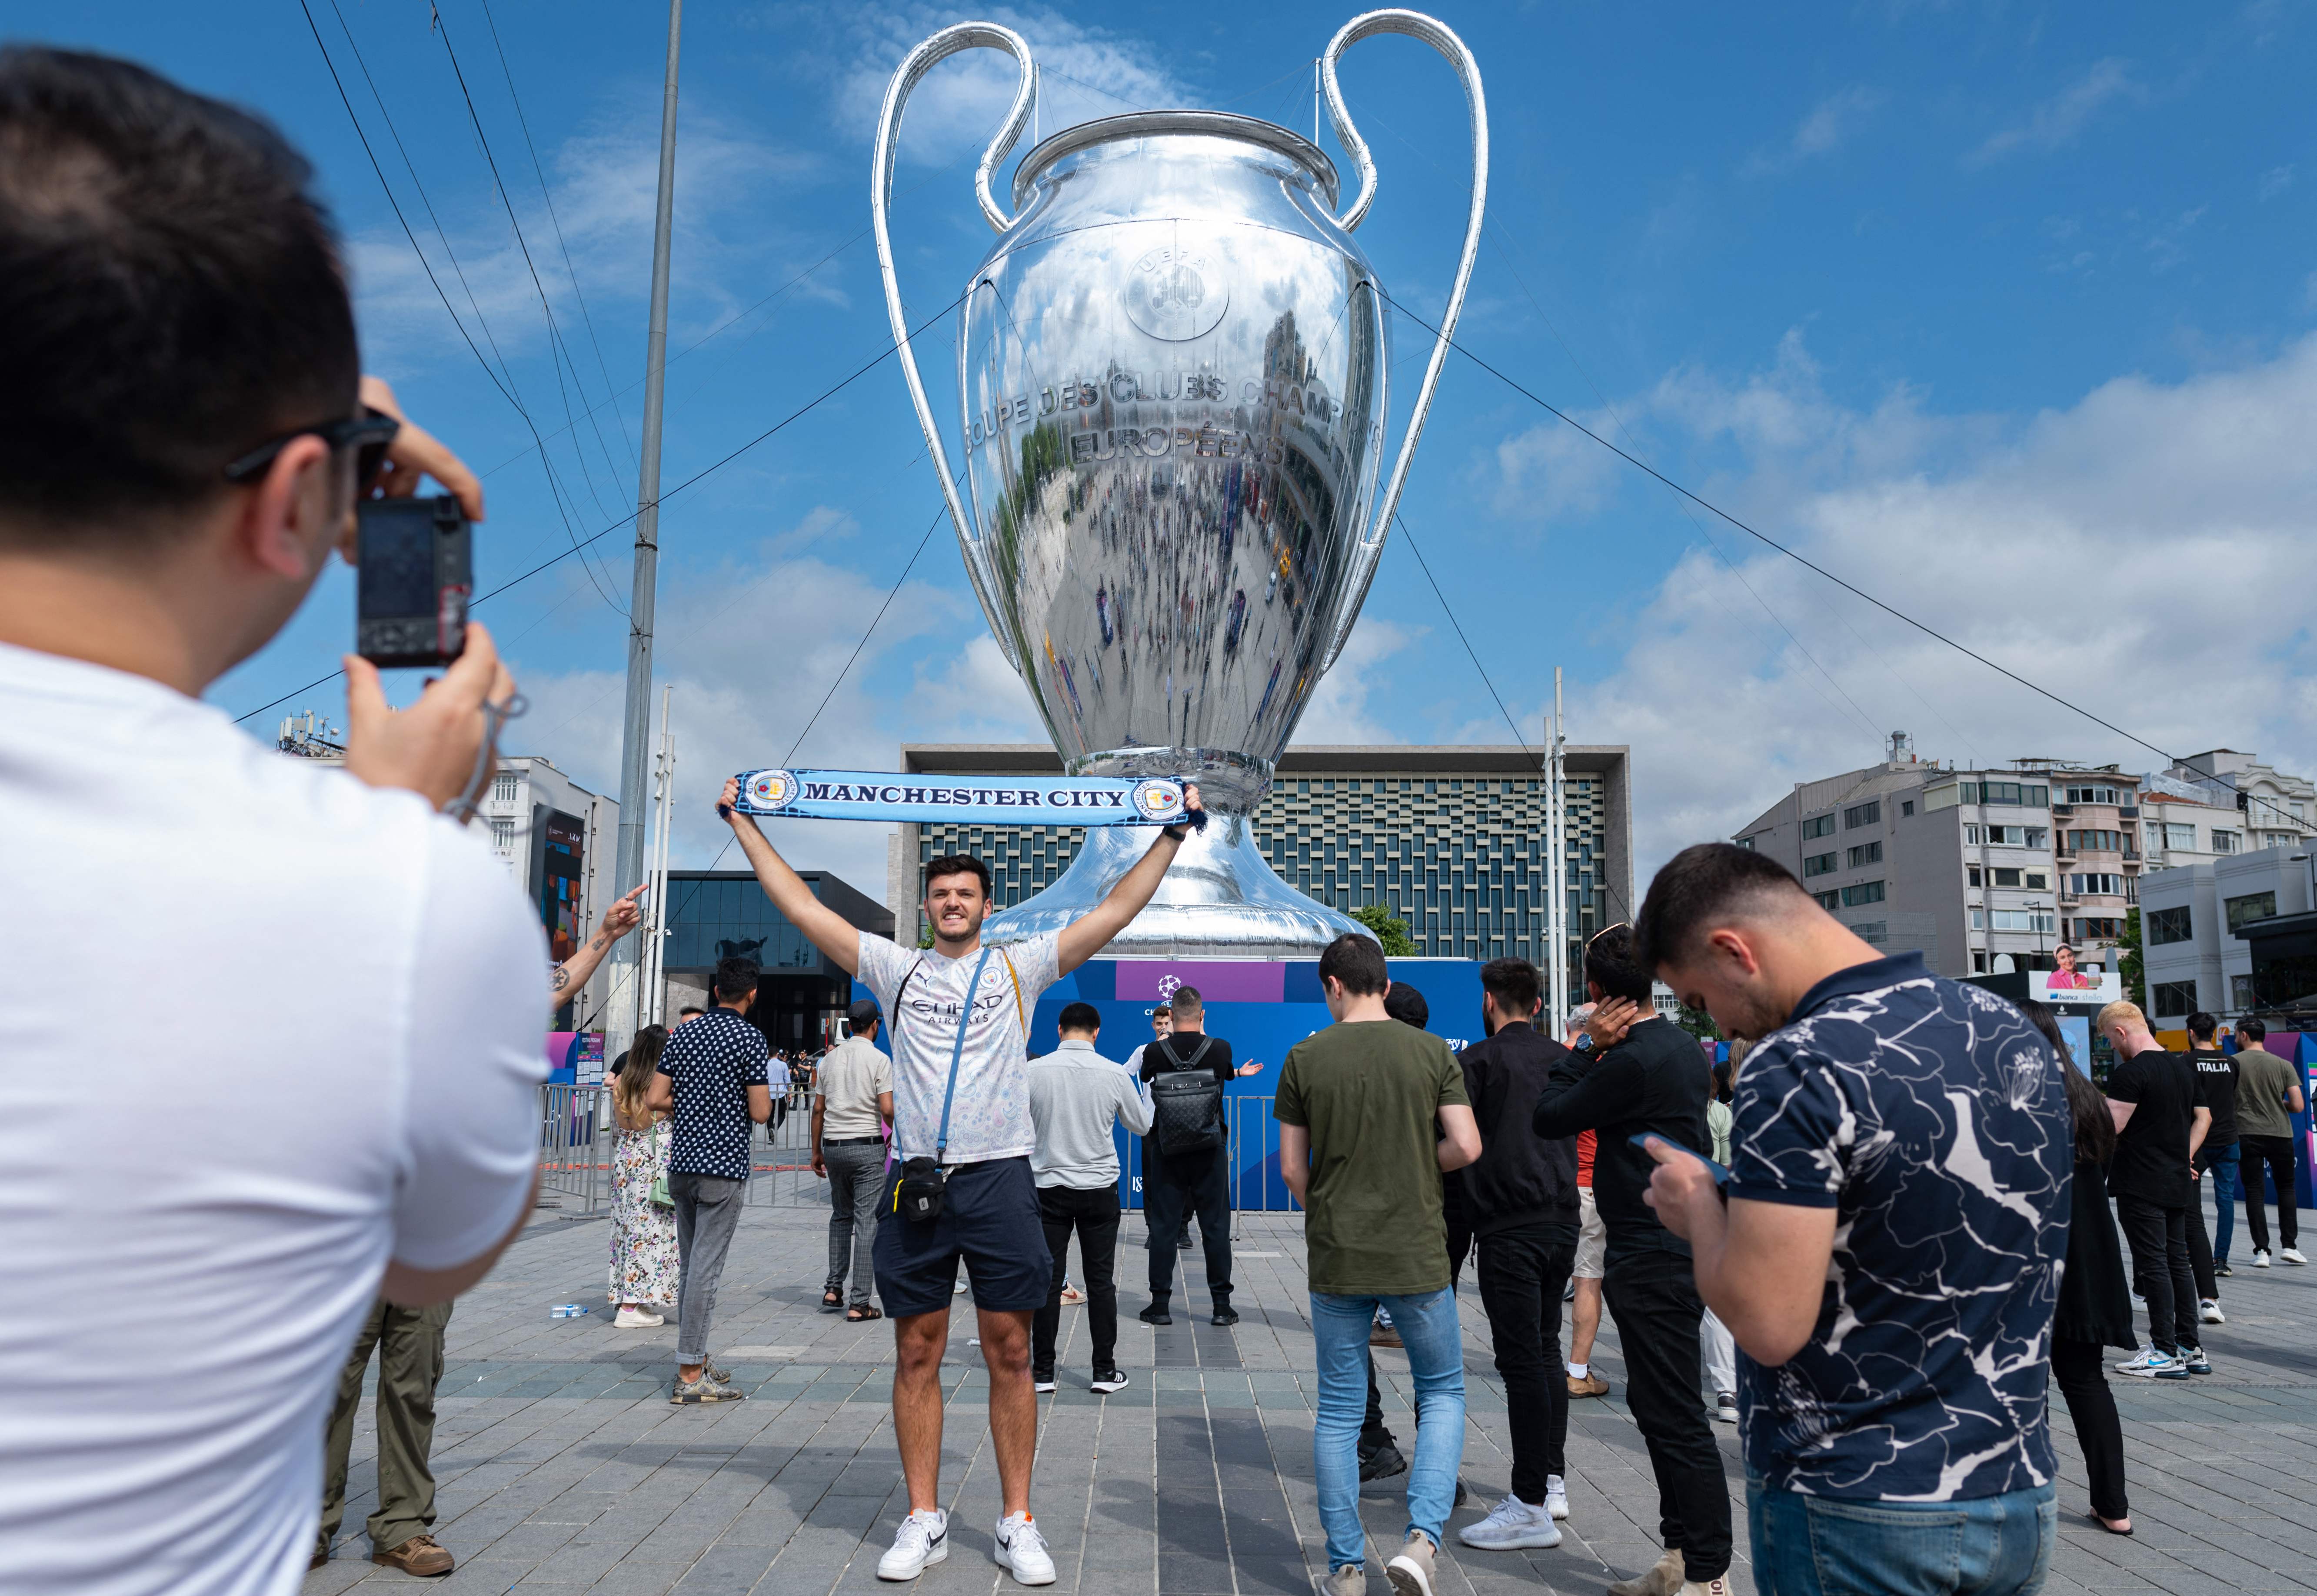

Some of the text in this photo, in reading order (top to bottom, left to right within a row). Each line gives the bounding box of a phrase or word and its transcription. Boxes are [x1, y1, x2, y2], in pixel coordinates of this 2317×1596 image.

[1139, 250, 1206, 273] UEFA
[966, 392, 1032, 455] COUPE
[1040, 377, 1100, 416] DES
[1109, 372, 1228, 403] CLUBS
[1070, 420, 1284, 465] EUROPÉENS
[775, 772, 797, 806] MANCHESTER
[802, 783, 1126, 807] MANCHESTER CITY
[1135, 782, 1154, 816] MANCHESTER
[2197, 1062, 2231, 1073] ITALIA
